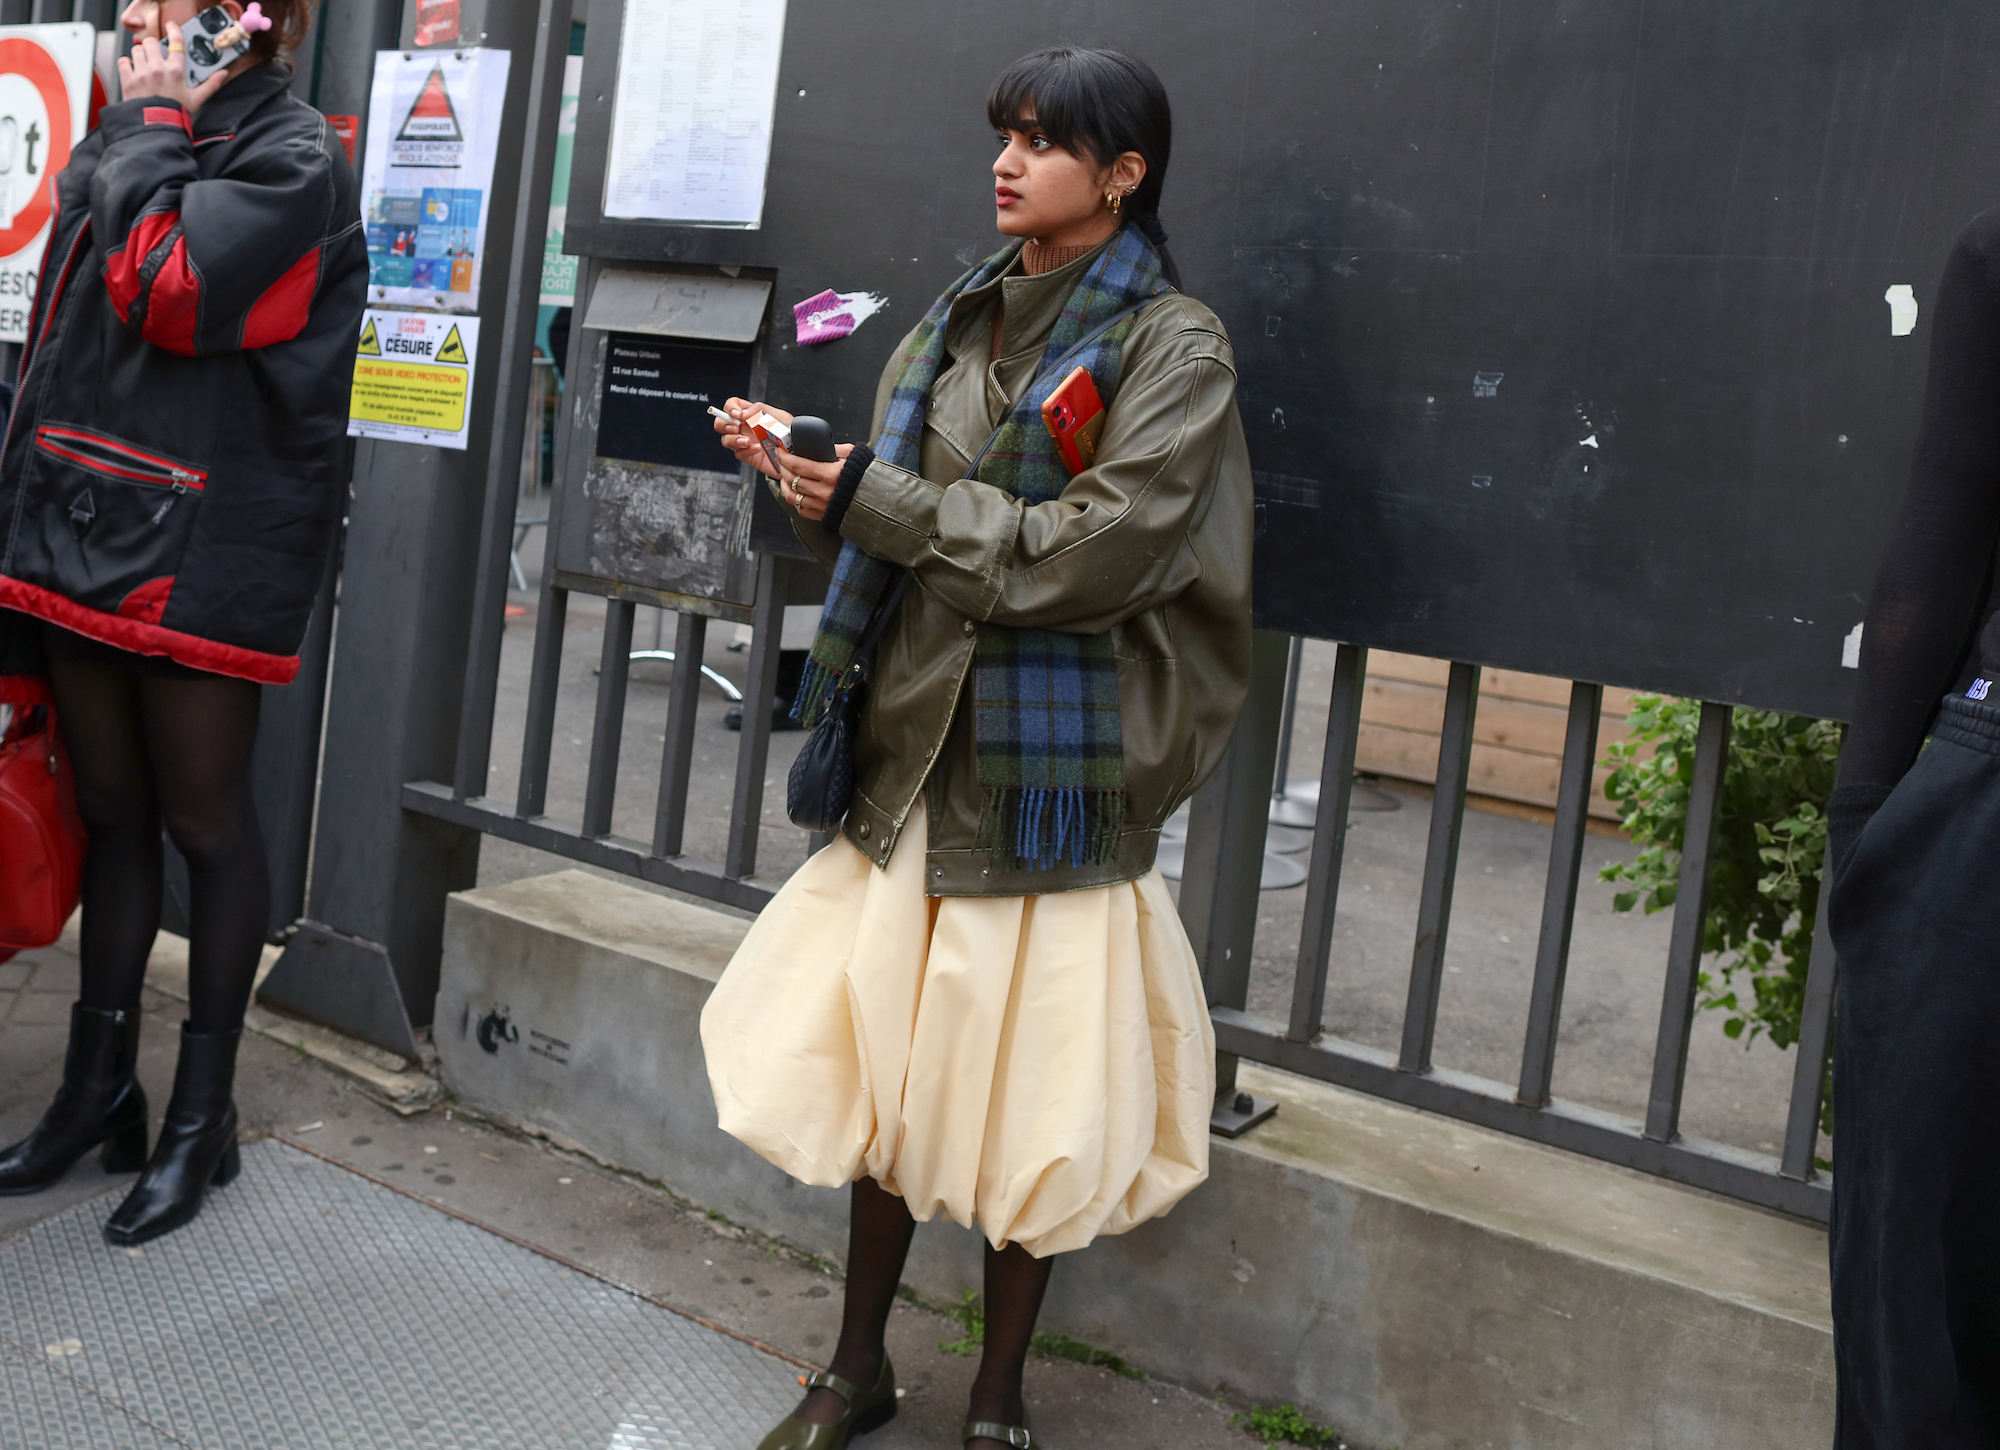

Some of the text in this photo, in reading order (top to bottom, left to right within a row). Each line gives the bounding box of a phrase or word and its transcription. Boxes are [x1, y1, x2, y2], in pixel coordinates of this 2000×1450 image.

[410, 123, 451, 131] VIGIPIRATE
[614, 348, 661, 360] Plateau Urbain
[375, 367, 394, 377] SOUS
[416, 371, 462, 384] PROTECTION
[612, 366, 660, 378] 13 rue Santeuil
[610, 384, 629, 394] Merci
[629, 386, 637, 395] de
[637, 387, 664, 398] déposer
[665, 390, 671, 398] le
[672, 391, 698, 401] courrier
